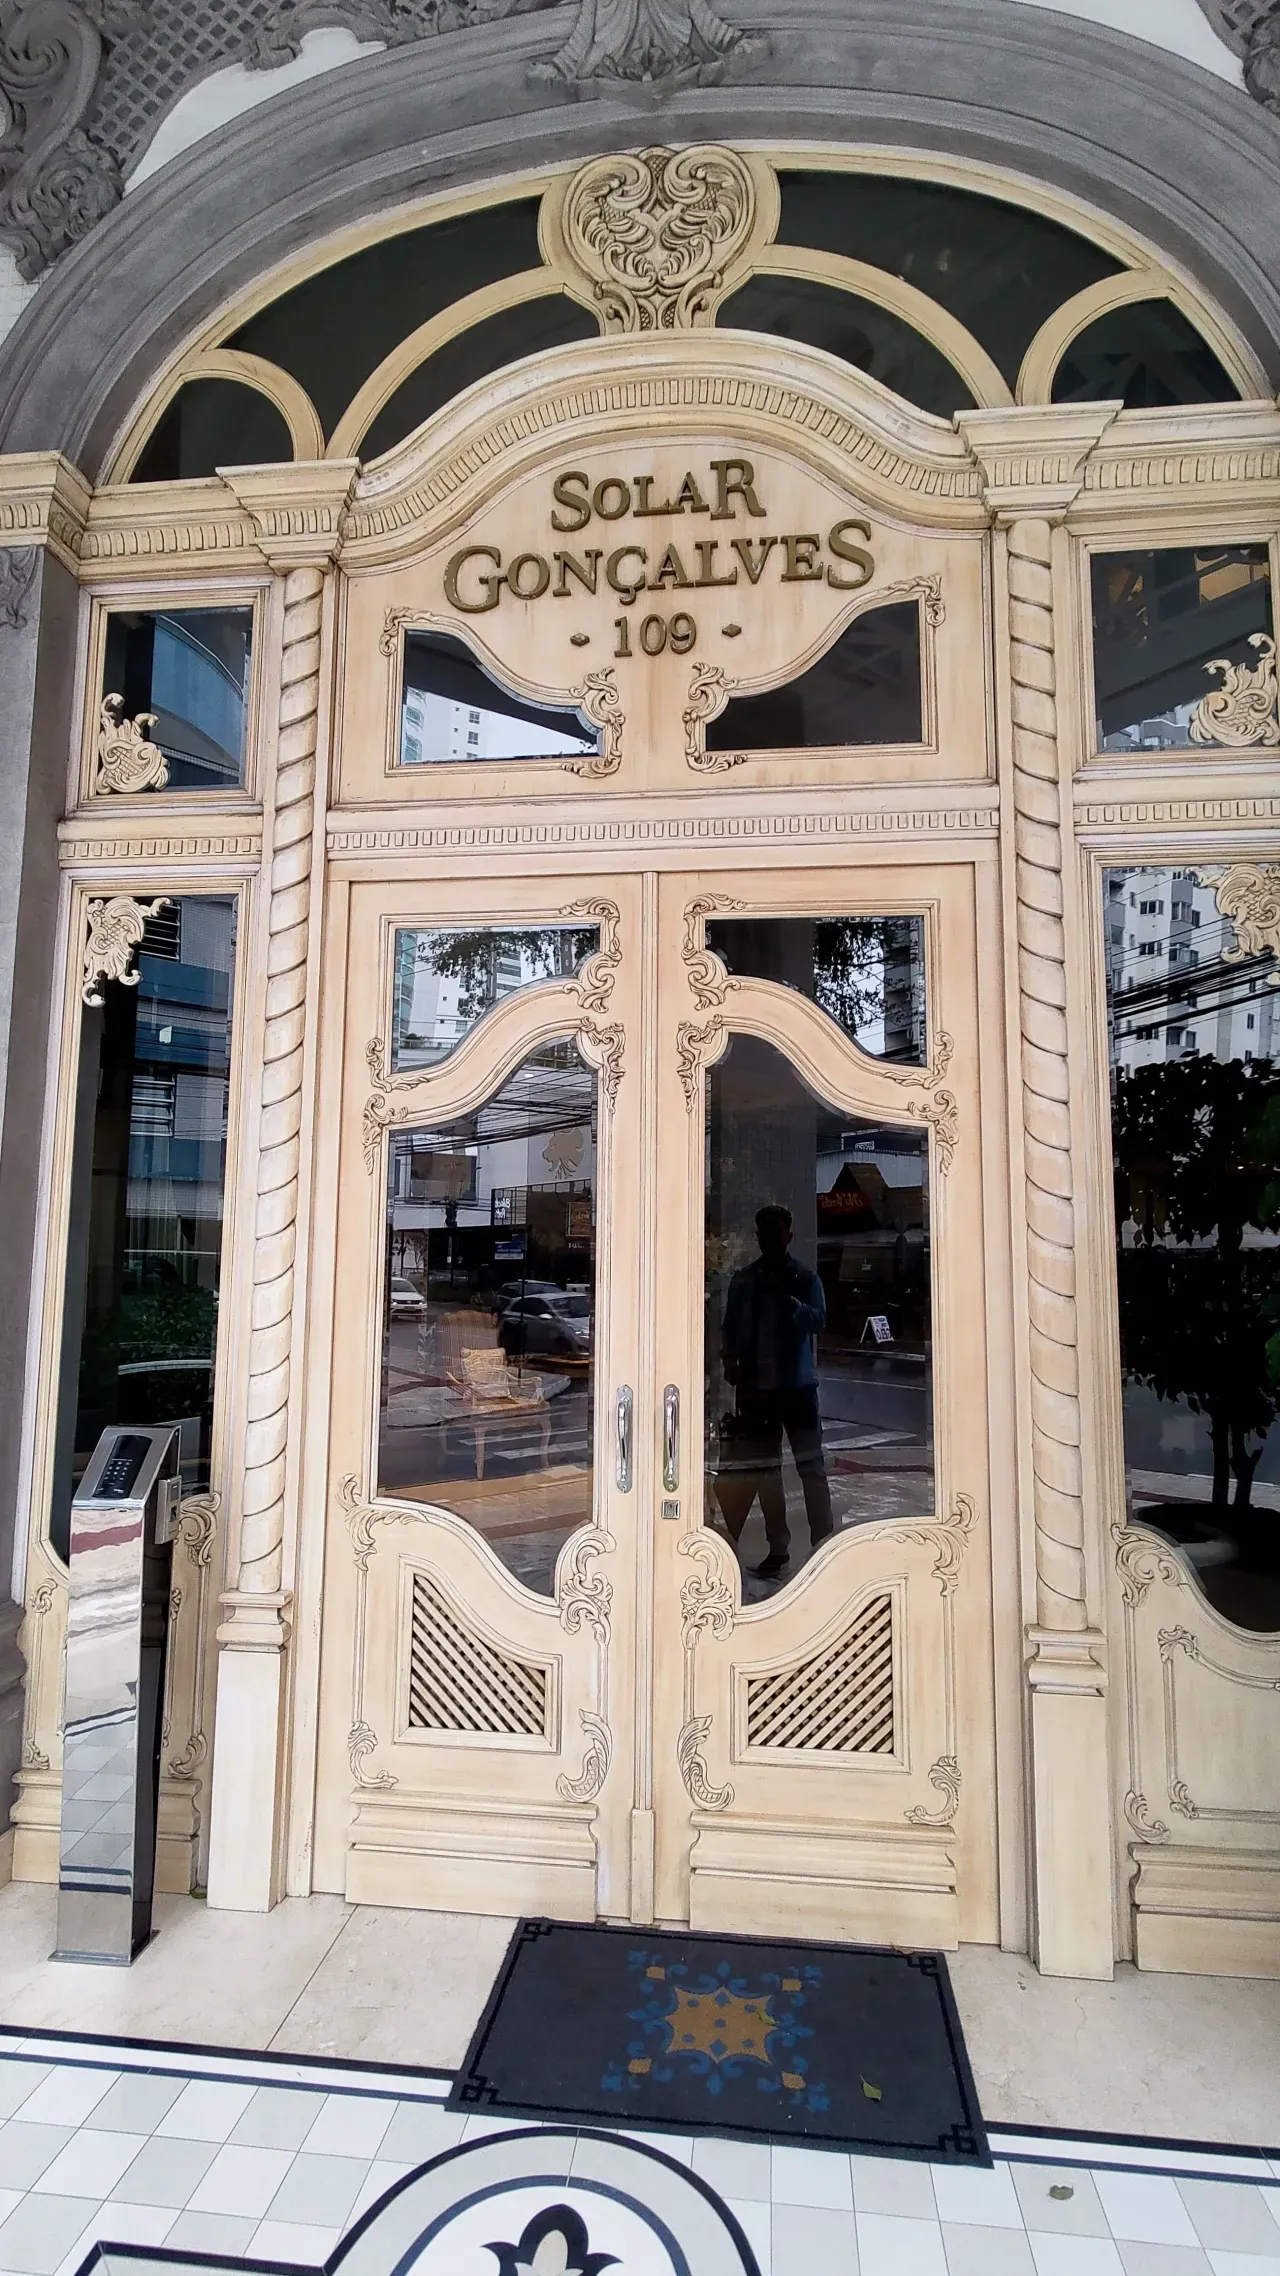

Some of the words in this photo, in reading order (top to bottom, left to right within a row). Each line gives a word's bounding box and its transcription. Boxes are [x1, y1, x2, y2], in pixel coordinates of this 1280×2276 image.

[550, 458, 767, 532] SOLAR
[443, 518, 876, 613] GONÇALVES
[614, 612, 696, 657] 109
